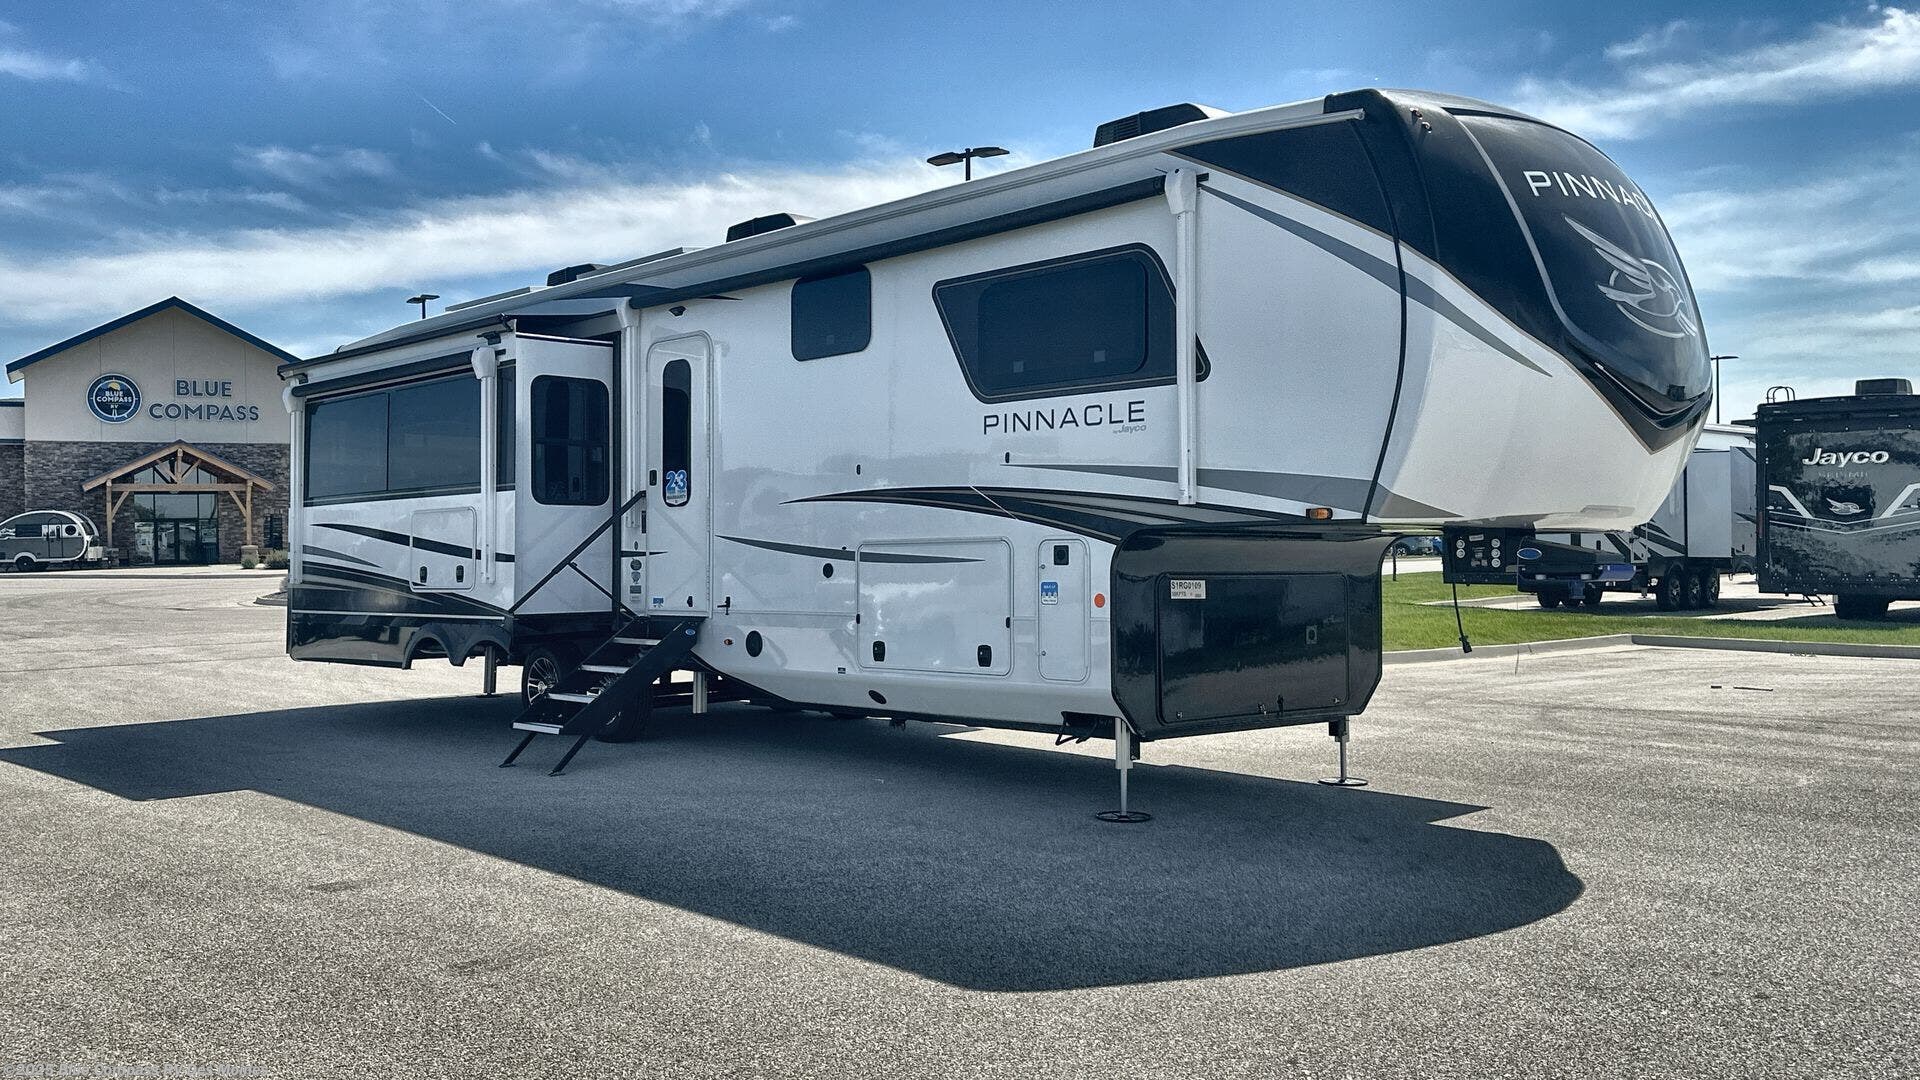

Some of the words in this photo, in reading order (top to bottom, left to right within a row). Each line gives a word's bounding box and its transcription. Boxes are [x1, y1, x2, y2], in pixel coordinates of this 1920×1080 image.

[1523, 170, 1656, 222] PINNAC
[175, 379, 233, 397] BLUE
[149, 403, 260, 421] COMPASS
[983, 401, 1145, 435] PINNACLE
[1119, 424, 1147, 434] Jayco
[1802, 448, 1890, 468] Jayco
